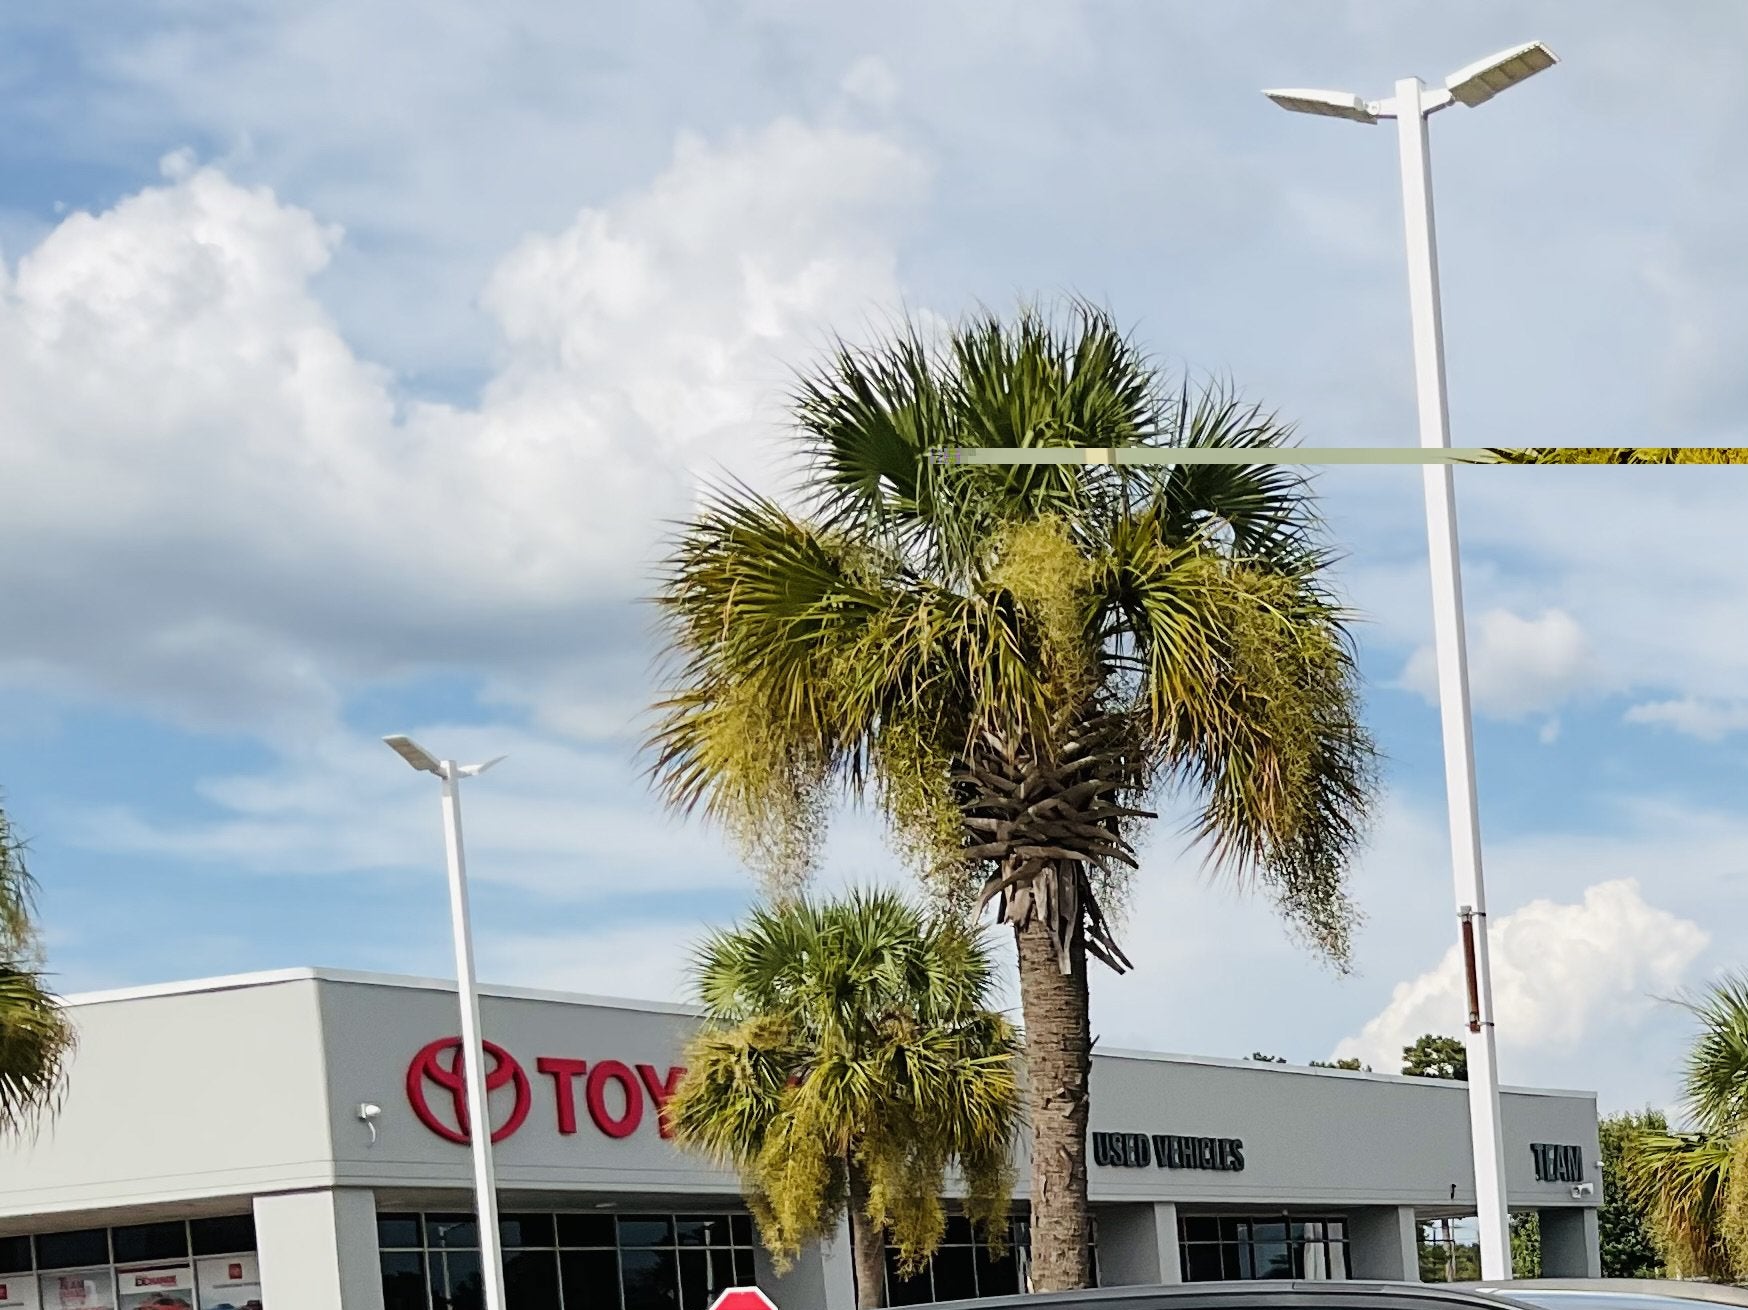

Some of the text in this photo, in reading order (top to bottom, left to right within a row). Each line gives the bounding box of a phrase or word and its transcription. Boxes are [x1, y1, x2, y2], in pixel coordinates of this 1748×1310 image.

[537, 1057, 687, 1140] TOY
[1092, 1132, 1245, 1171] USED VEHICLES
[1530, 1143, 1584, 1182] TEAM
